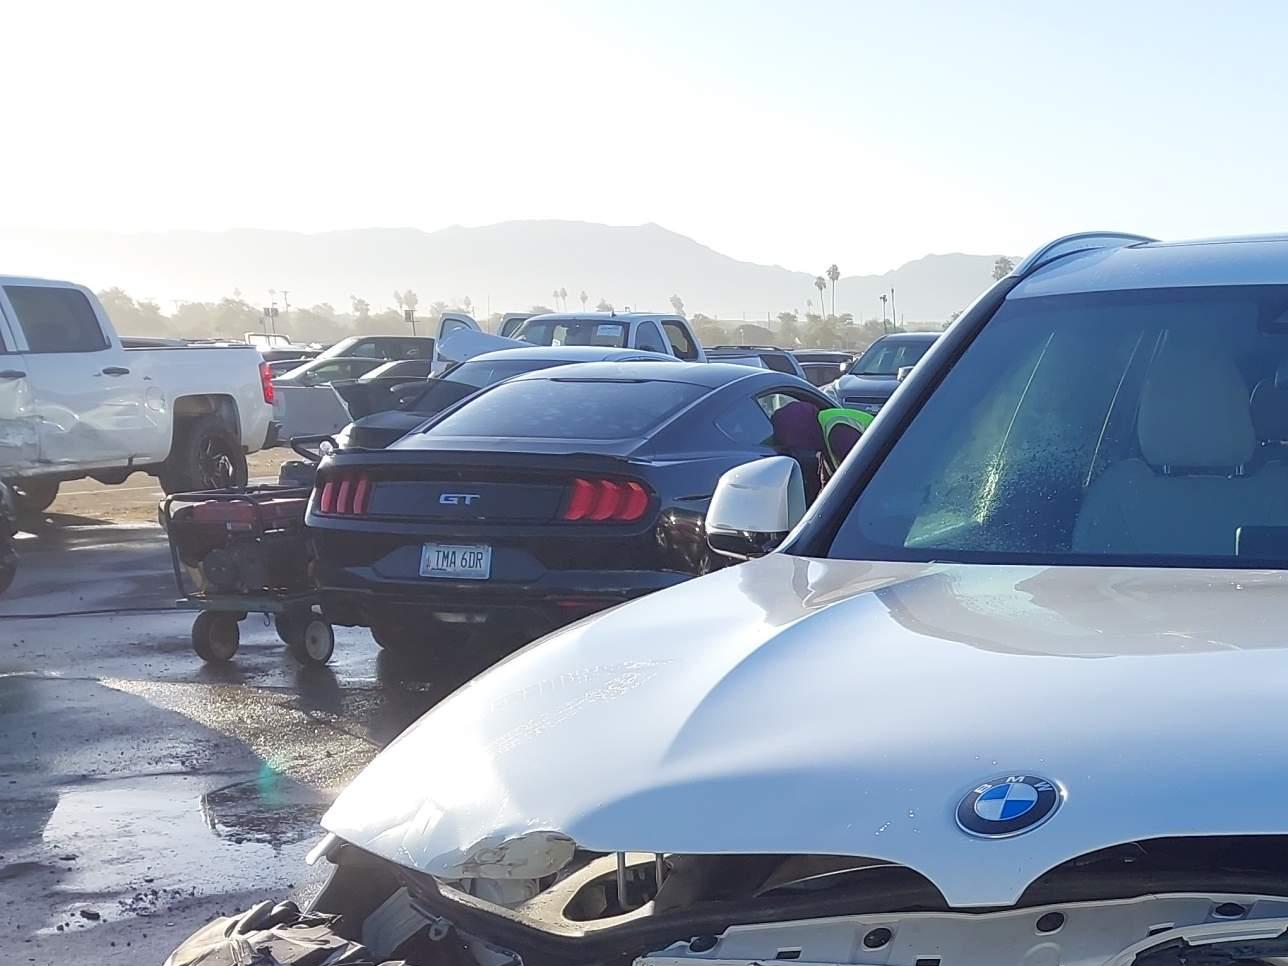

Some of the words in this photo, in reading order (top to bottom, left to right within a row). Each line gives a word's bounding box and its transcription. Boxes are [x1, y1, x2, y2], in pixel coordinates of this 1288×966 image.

[440, 493, 481, 505] GT
[435, 550, 456, 569] TMA
[974, 776, 1053, 794] BMW
